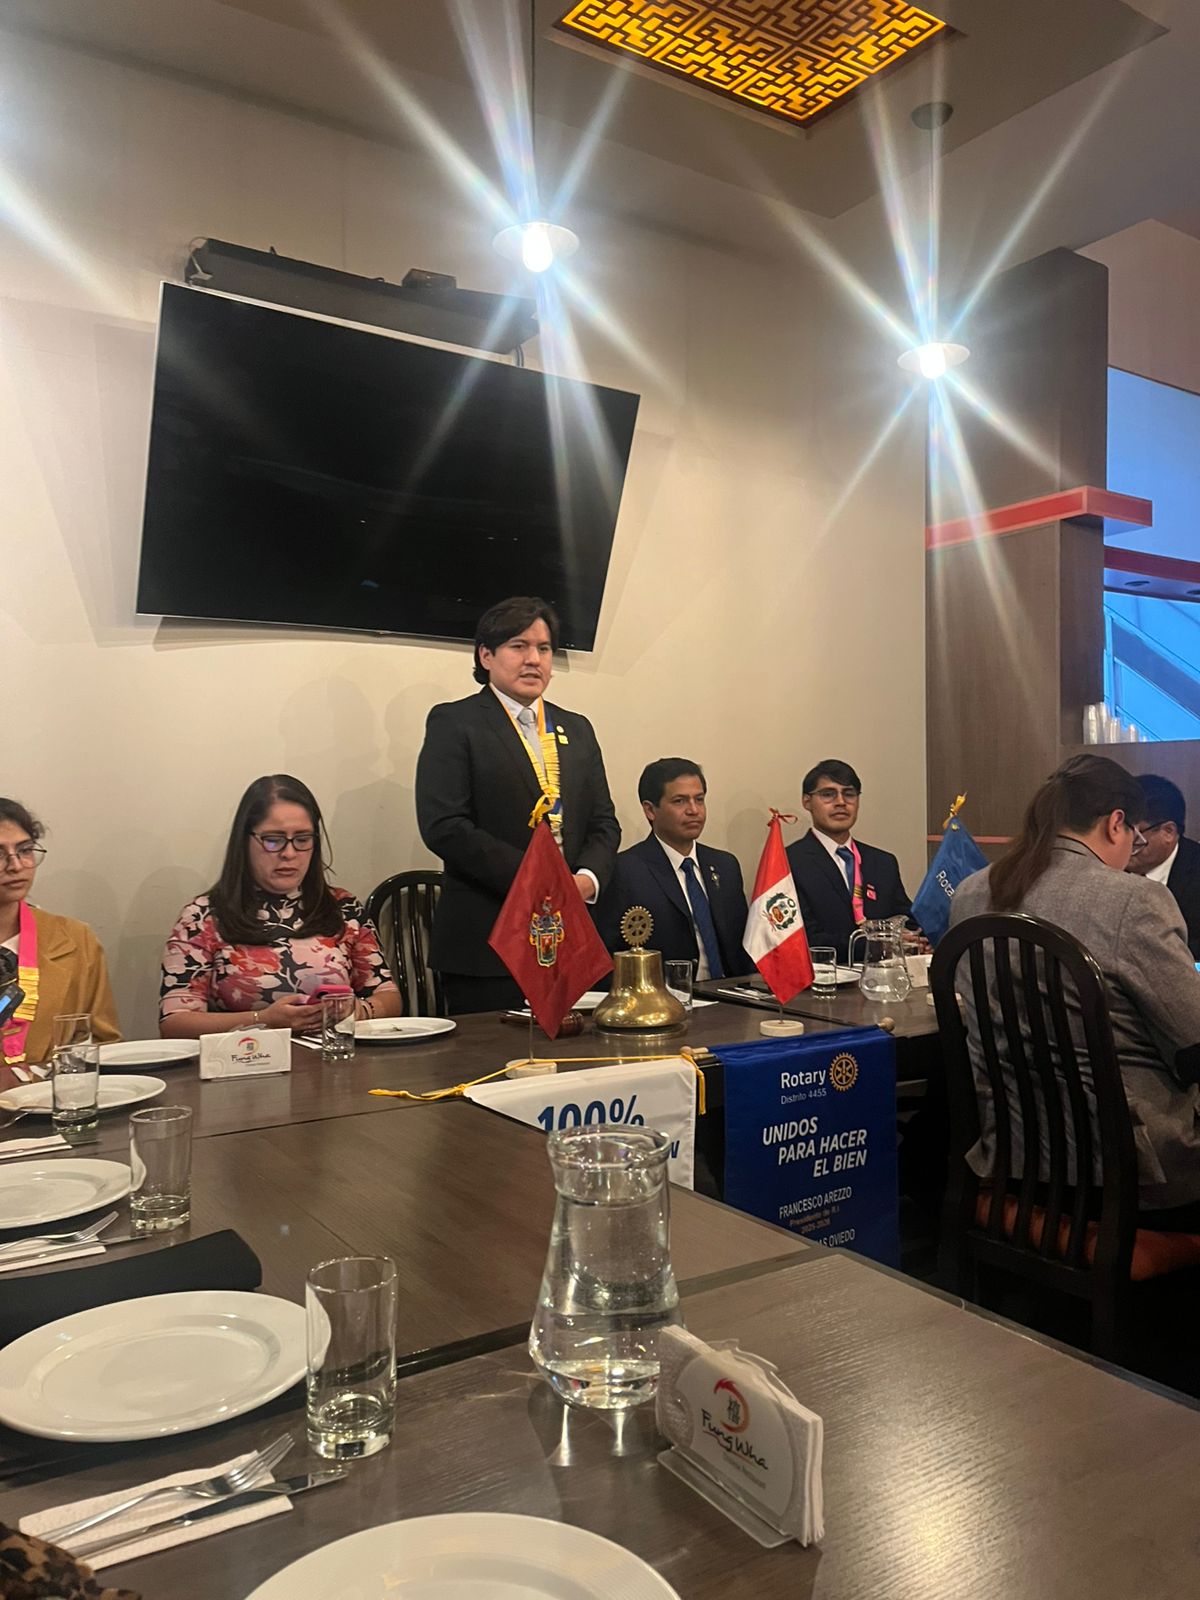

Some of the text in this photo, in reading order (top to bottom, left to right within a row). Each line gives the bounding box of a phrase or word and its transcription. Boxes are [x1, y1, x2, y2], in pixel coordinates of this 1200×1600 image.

[780, 1069, 827, 1089] Rotary
[780, 1087, 827, 1105] Distrito 4455
[762, 1116, 818, 1146] UNIDOS
[778, 1129, 868, 1166] PARA HACER
[813, 1149, 868, 1178] EL BIEN
[778, 1194, 823, 1220] FRANCESCO
[823, 1186, 852, 1206] AREZZO
[828, 1228, 856, 1248] OVIEDO
[701, 1408, 734, 1452] Fung
[735, 1437, 769, 1470] Wha
